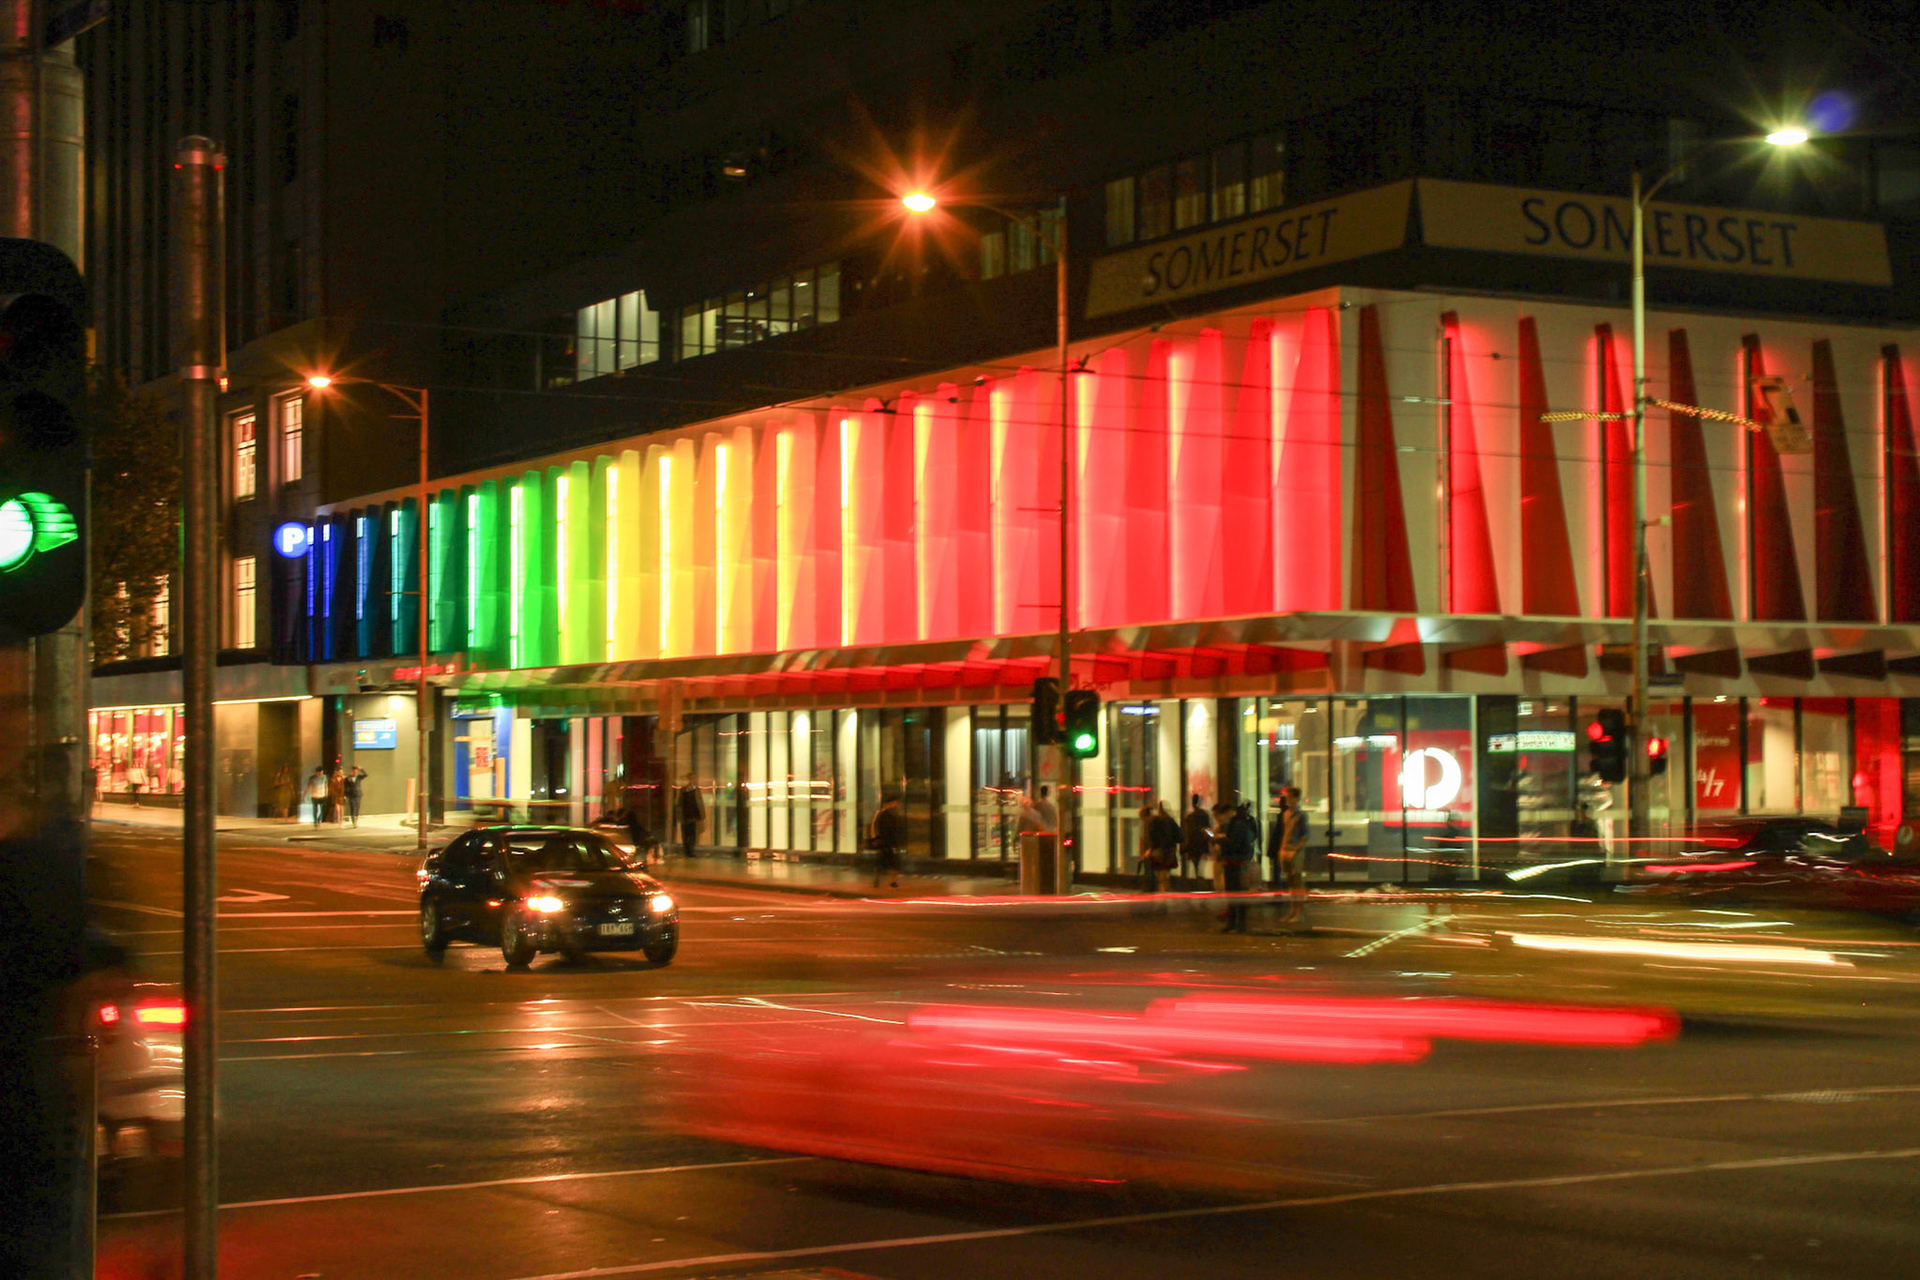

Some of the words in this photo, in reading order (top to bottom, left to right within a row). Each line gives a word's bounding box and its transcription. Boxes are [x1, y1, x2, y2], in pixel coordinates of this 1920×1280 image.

[1143, 208, 1337, 295] SOMERSET
[1521, 198, 1798, 268] SOMERSET
[282, 527, 305, 553] P
